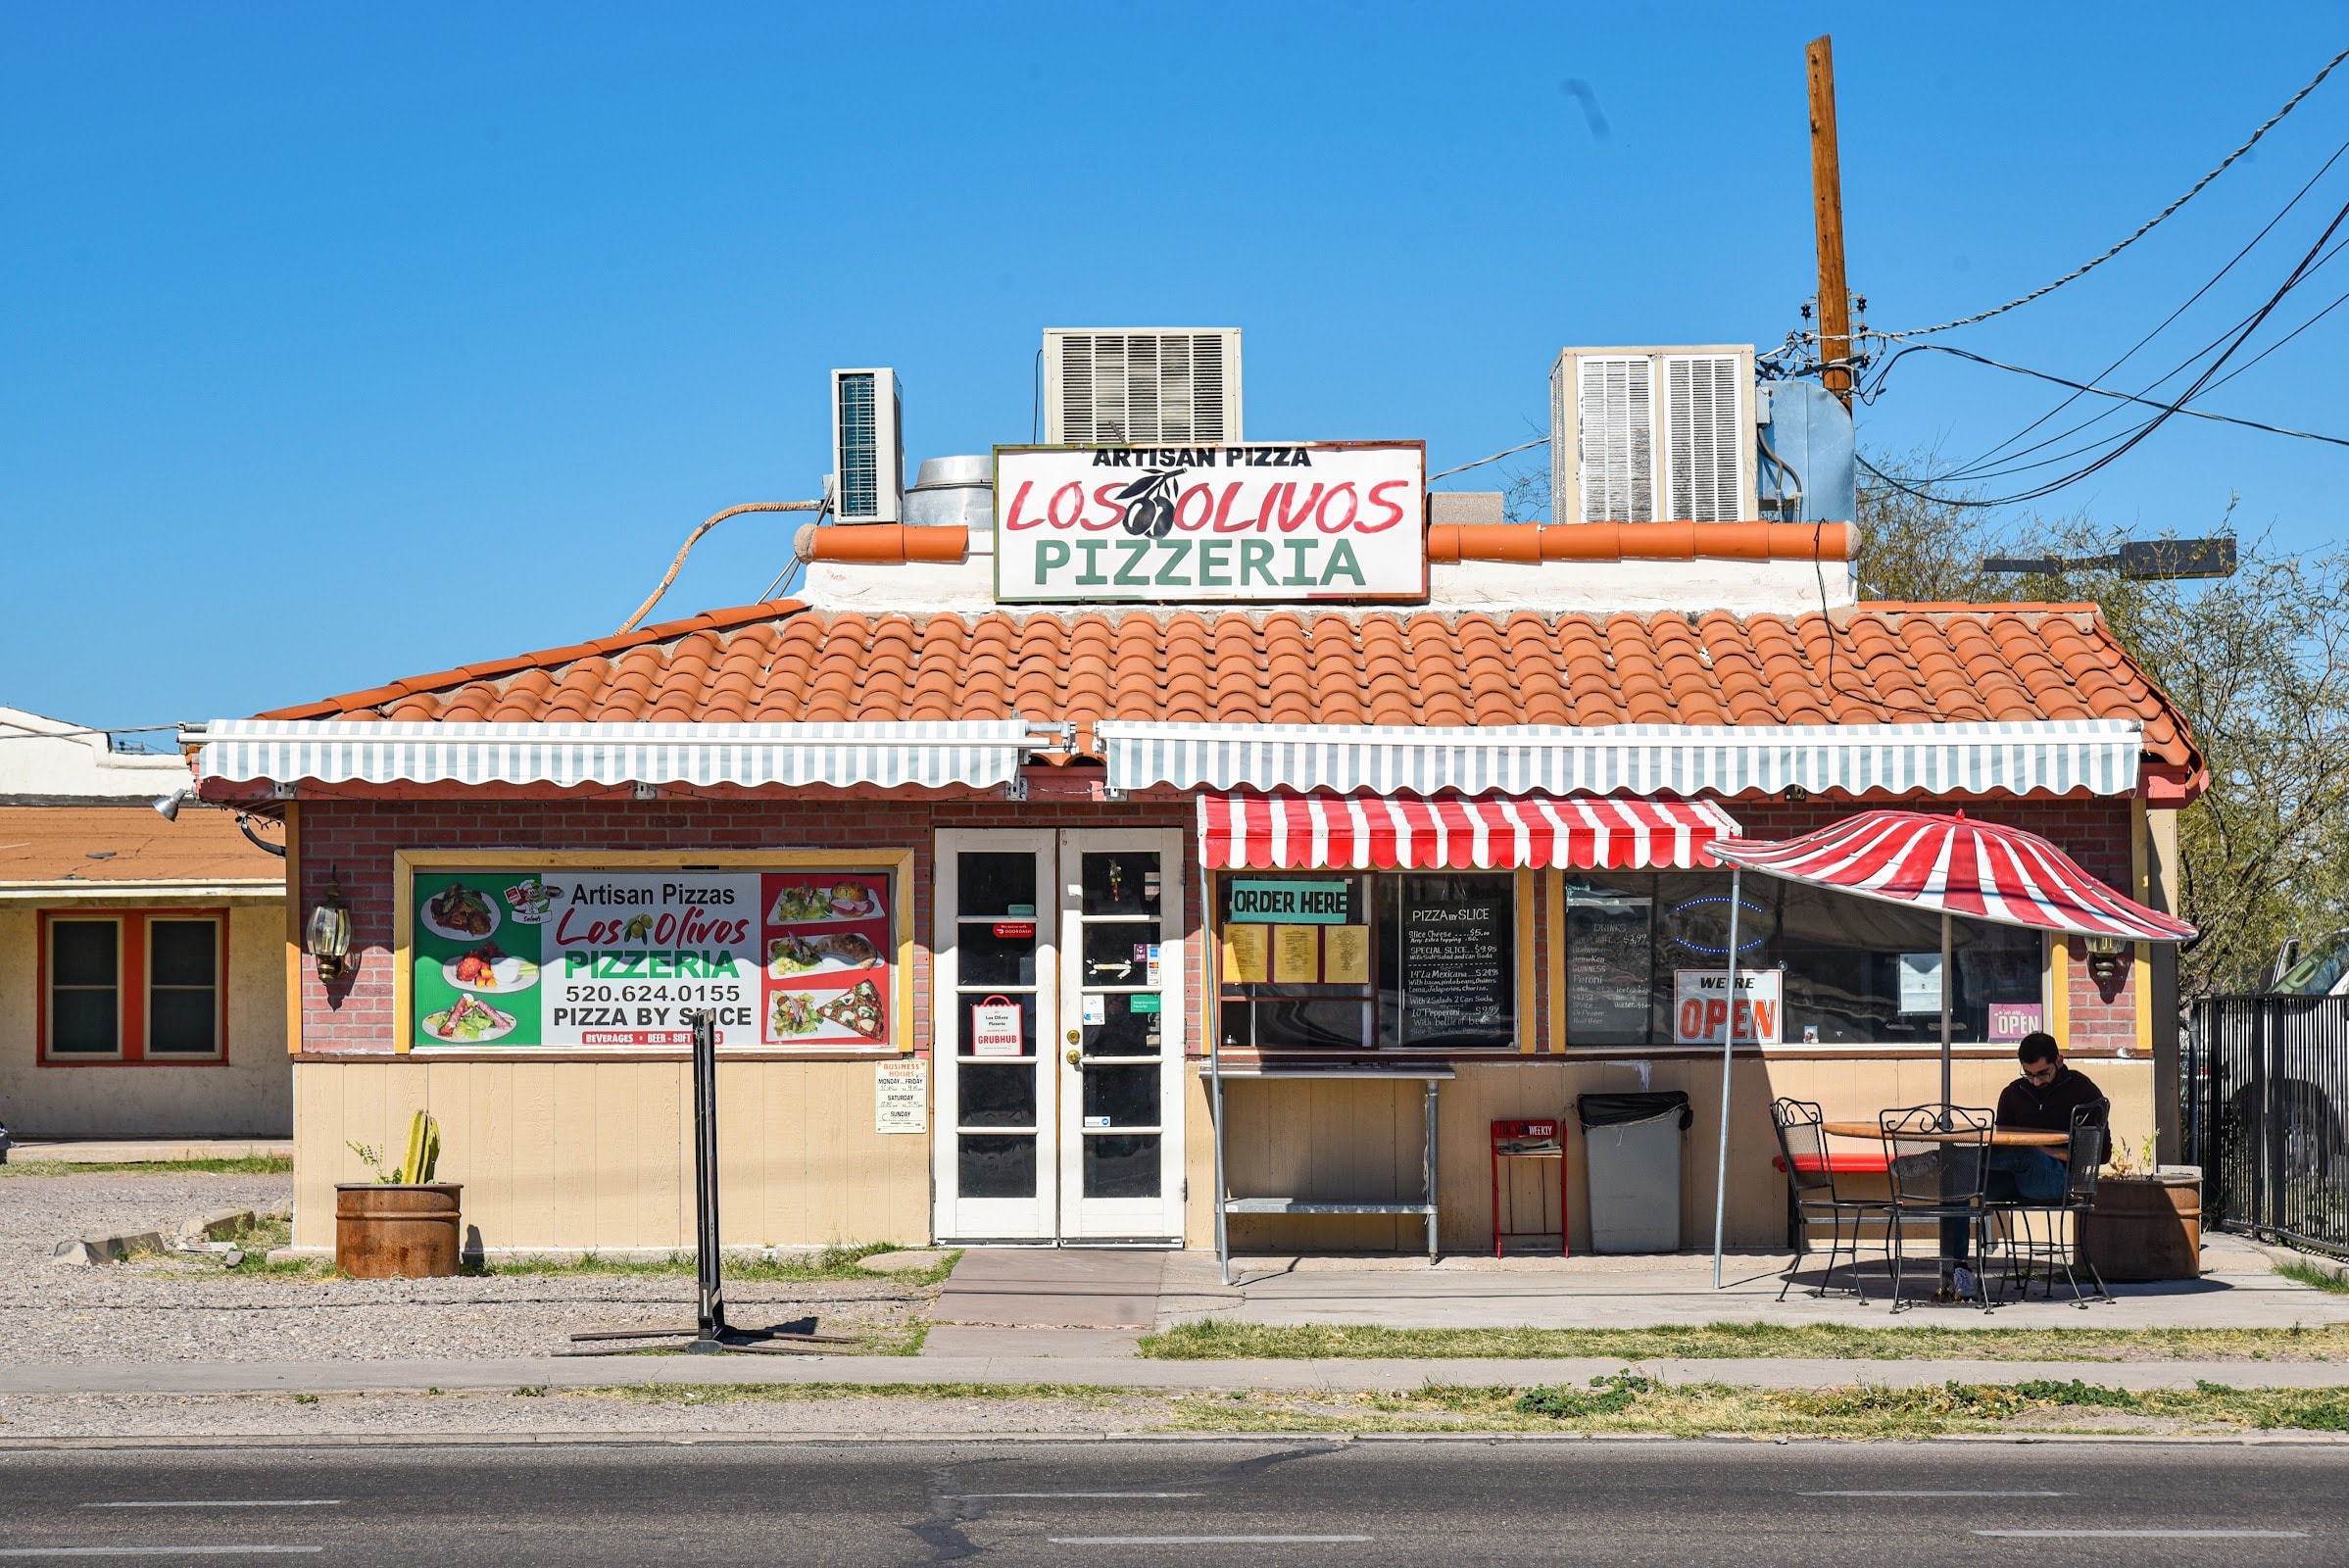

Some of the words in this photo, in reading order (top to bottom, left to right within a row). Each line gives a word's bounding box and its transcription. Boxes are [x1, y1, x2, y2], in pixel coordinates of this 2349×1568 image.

[1092, 448, 1216, 467] ARTISAN
[1226, 448, 1312, 467] PIZZA
[1006, 481, 1129, 531] LOS
[1173, 480, 1409, 534] OLIVOS
[1035, 538, 1366, 586] PIZZERIA
[570, 884, 654, 905] Artisan
[662, 884, 735, 905] Pizzas
[1235, 890, 1295, 912] ORDER
[1300, 892, 1347, 913] HERE
[1412, 909, 1448, 922] PIZZA
[1458, 908, 1490, 920] SLICE
[556, 907, 623, 946] Los
[654, 906, 750, 949] Olivos
[1408, 930, 1426, 939] Slice
[1427, 929, 1452, 938] Cheese
[1594, 923, 1627, 932] DRINKS
[564, 950, 740, 979] PIZZERIA
[1432, 969, 1468, 978] Mexicana
[1573, 974, 1603, 984] Peroni
[565, 985, 740, 1003] 520.624.0155
[1431, 996, 1452, 1004] Salads
[554, 1007, 628, 1026] PIZZA
[637, 1007, 670, 1026] BY
[678, 1007, 752, 1026] SICE
[1424, 1007, 1460, 1019] Pepperoni
[1458, 1015, 1467, 1025] of
[1680, 998, 1776, 1039] OPEN
[1998, 1015, 2038, 1035] OPEN
[586, 1033, 634, 1044] BEVERAGES
[647, 1033, 666, 1044] BEER
[673, 1033, 692, 1044] SOFT
[978, 1035, 1017, 1045] GRUBHUB
[1529, 1125, 1552, 1136] WEEKLY
